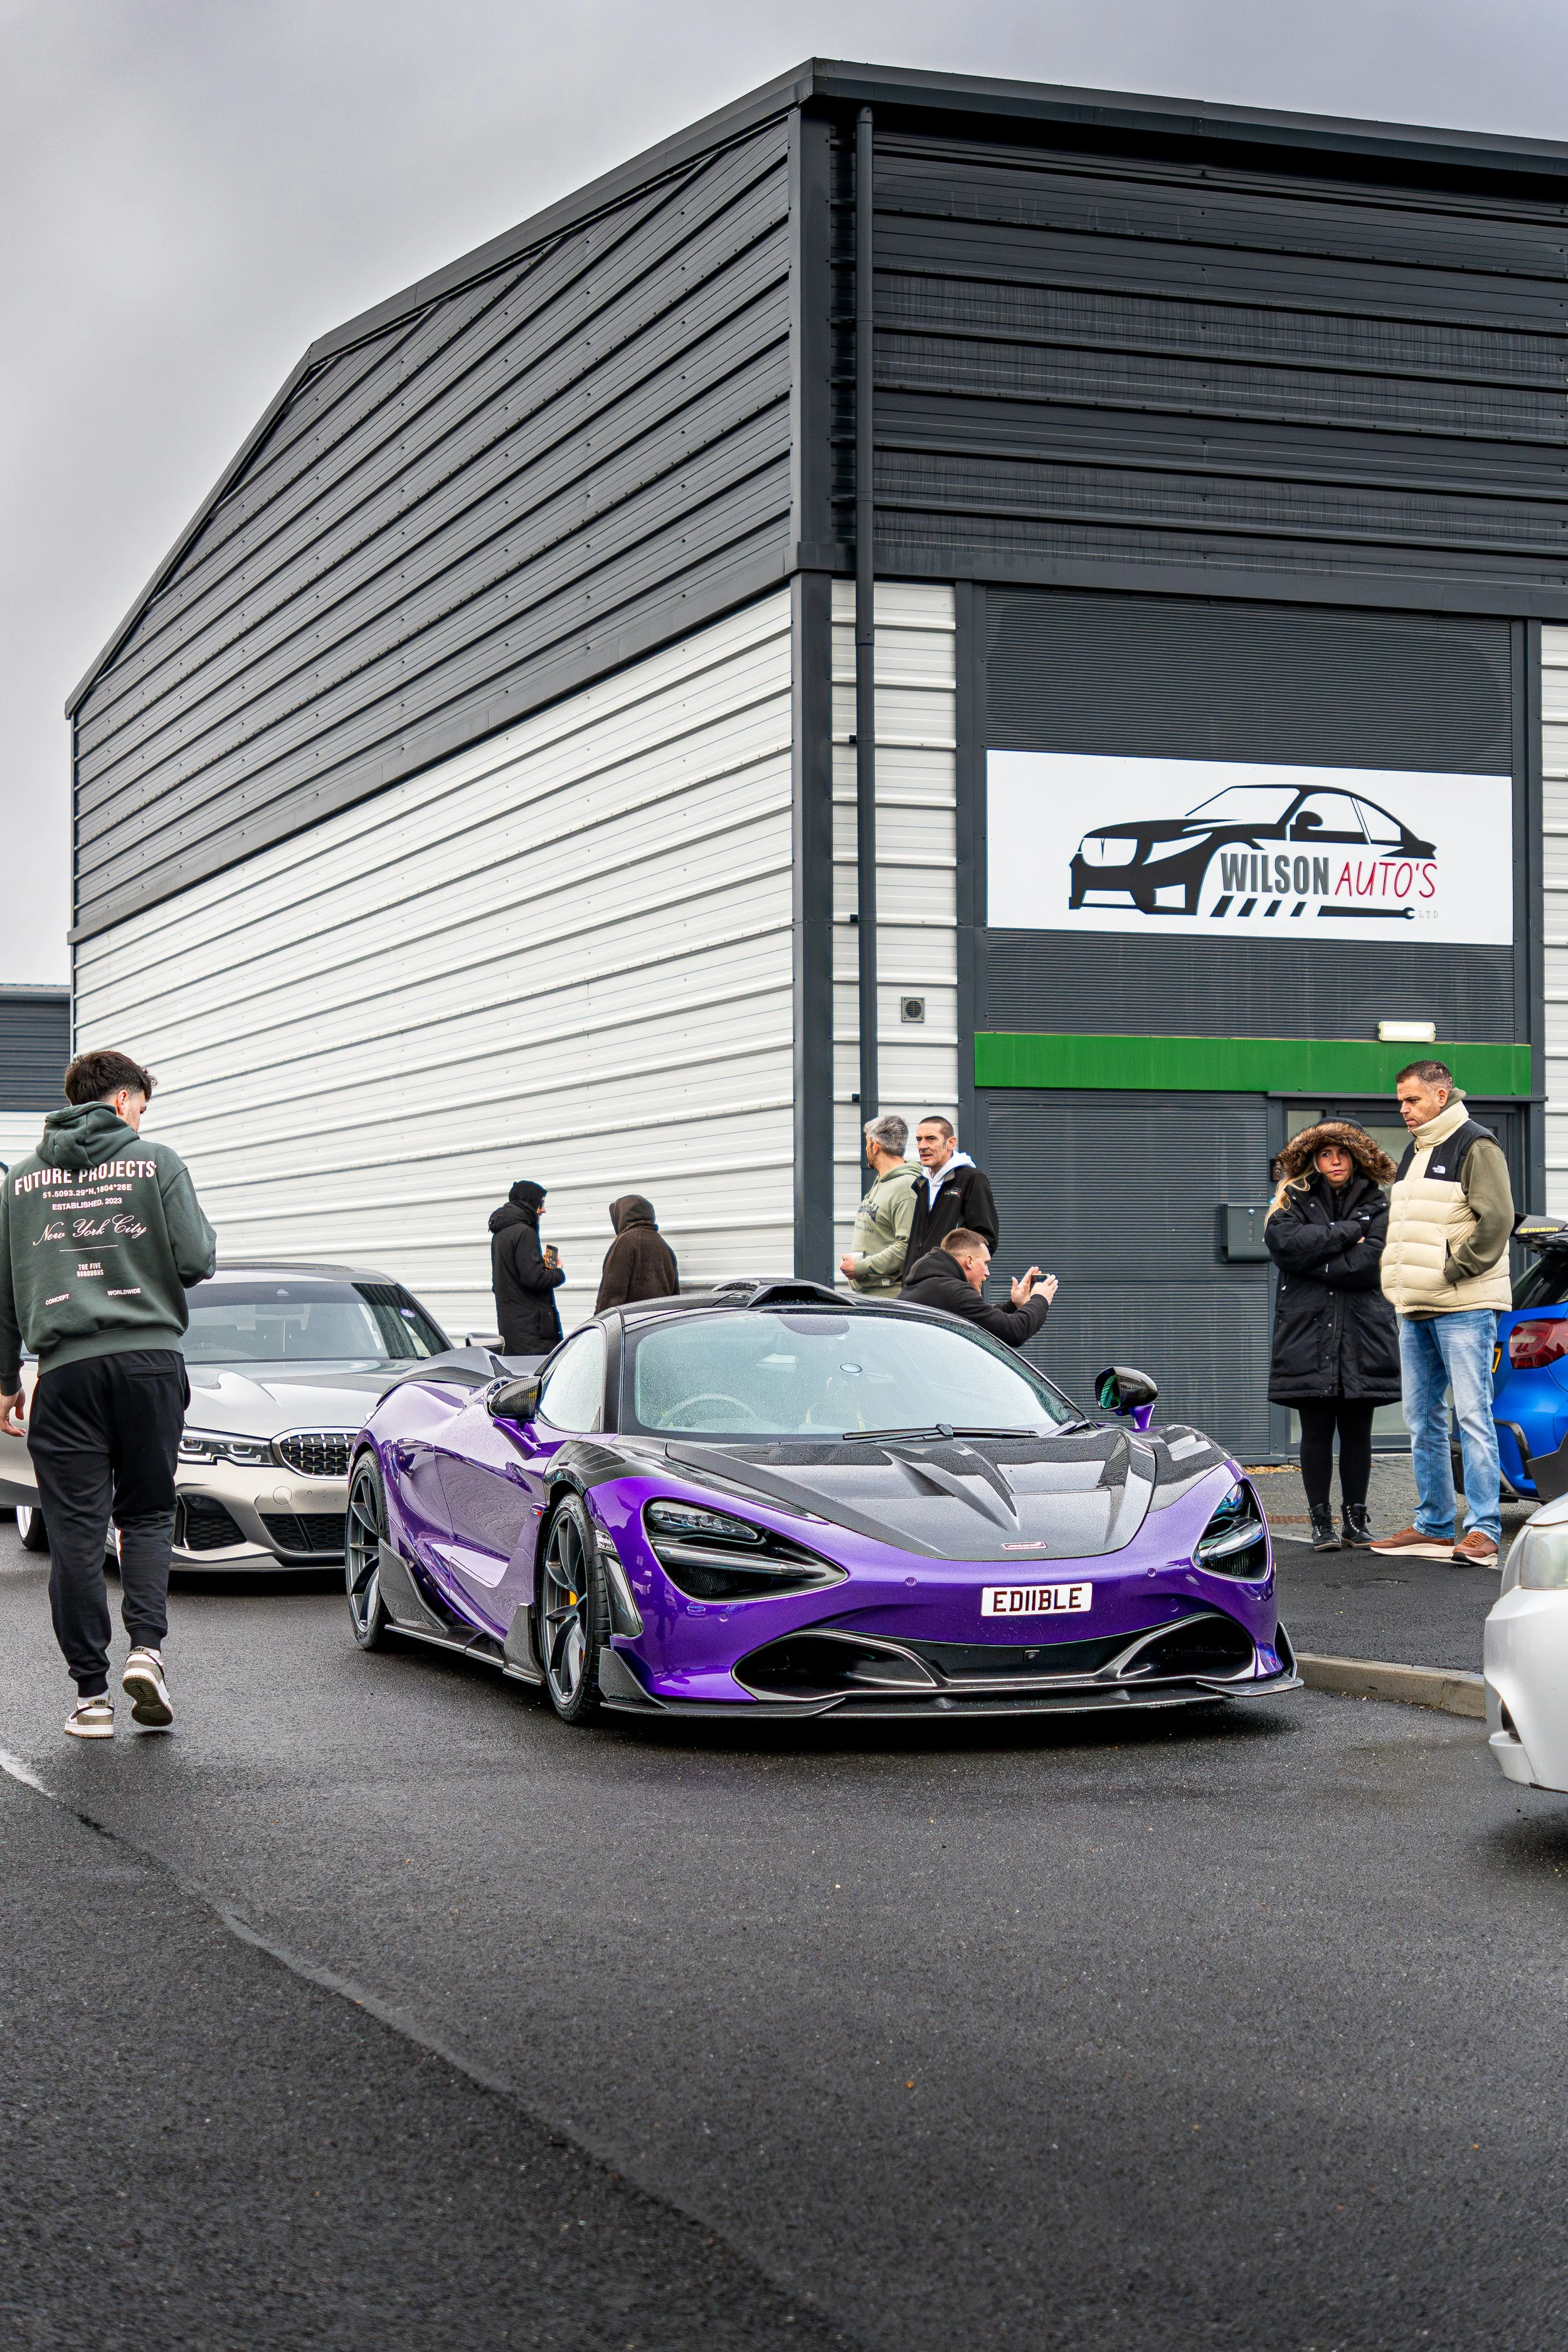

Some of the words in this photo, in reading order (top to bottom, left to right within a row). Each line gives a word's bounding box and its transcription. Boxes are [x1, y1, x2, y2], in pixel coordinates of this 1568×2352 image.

[1220, 852, 1330, 896] WILSON
[1335, 861, 1438, 898] AUTO'S
[1419, 910, 1439, 919] LTD
[14, 1168, 73, 1195] FUTURE
[78, 1160, 156, 1184] PROJECTS
[52, 1200, 103, 1210] ESTABLISHED.
[32, 1222, 66, 1246] New
[72, 1219, 111, 1237] York
[112, 1214, 147, 1239] City
[77, 1269, 104, 1277] BOROUGHS
[107, 1288, 141, 1296] WORLDWIDE
[45, 1293, 70, 1305] CONCEPT
